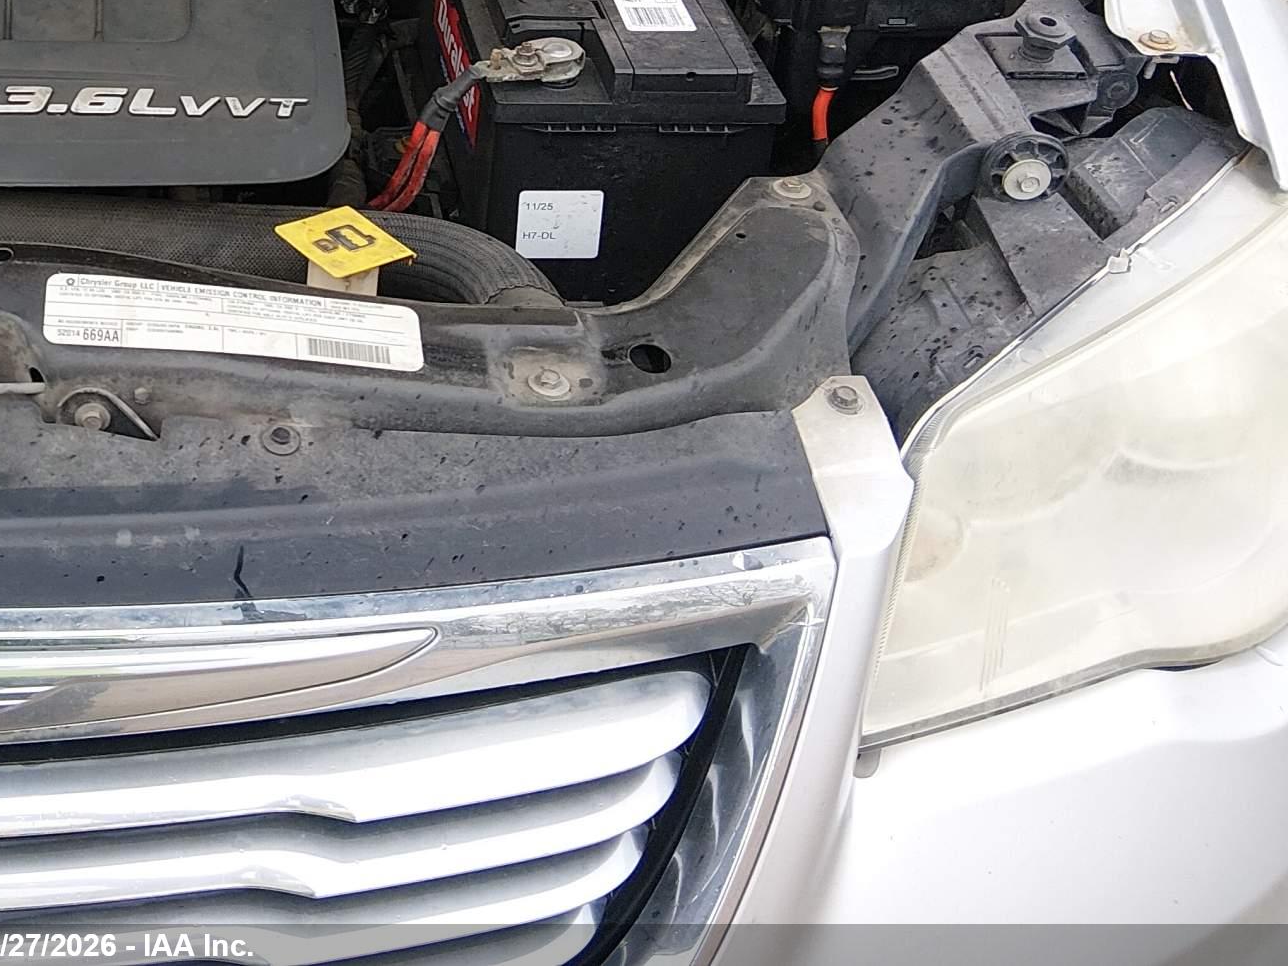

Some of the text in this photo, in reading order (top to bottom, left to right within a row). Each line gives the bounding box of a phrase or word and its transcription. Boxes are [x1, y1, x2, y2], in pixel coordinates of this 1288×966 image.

[526, 202, 554, 211] 11/25
[522, 231, 557, 240] H7-DL
[79, 277, 155, 290] Chrysler Group LLC
[161, 284, 191, 294] VEHICLE
[194, 287, 230, 297] EMISSION
[269, 295, 322, 307] INFORMATION
[83, 328, 119, 342] 669AA
